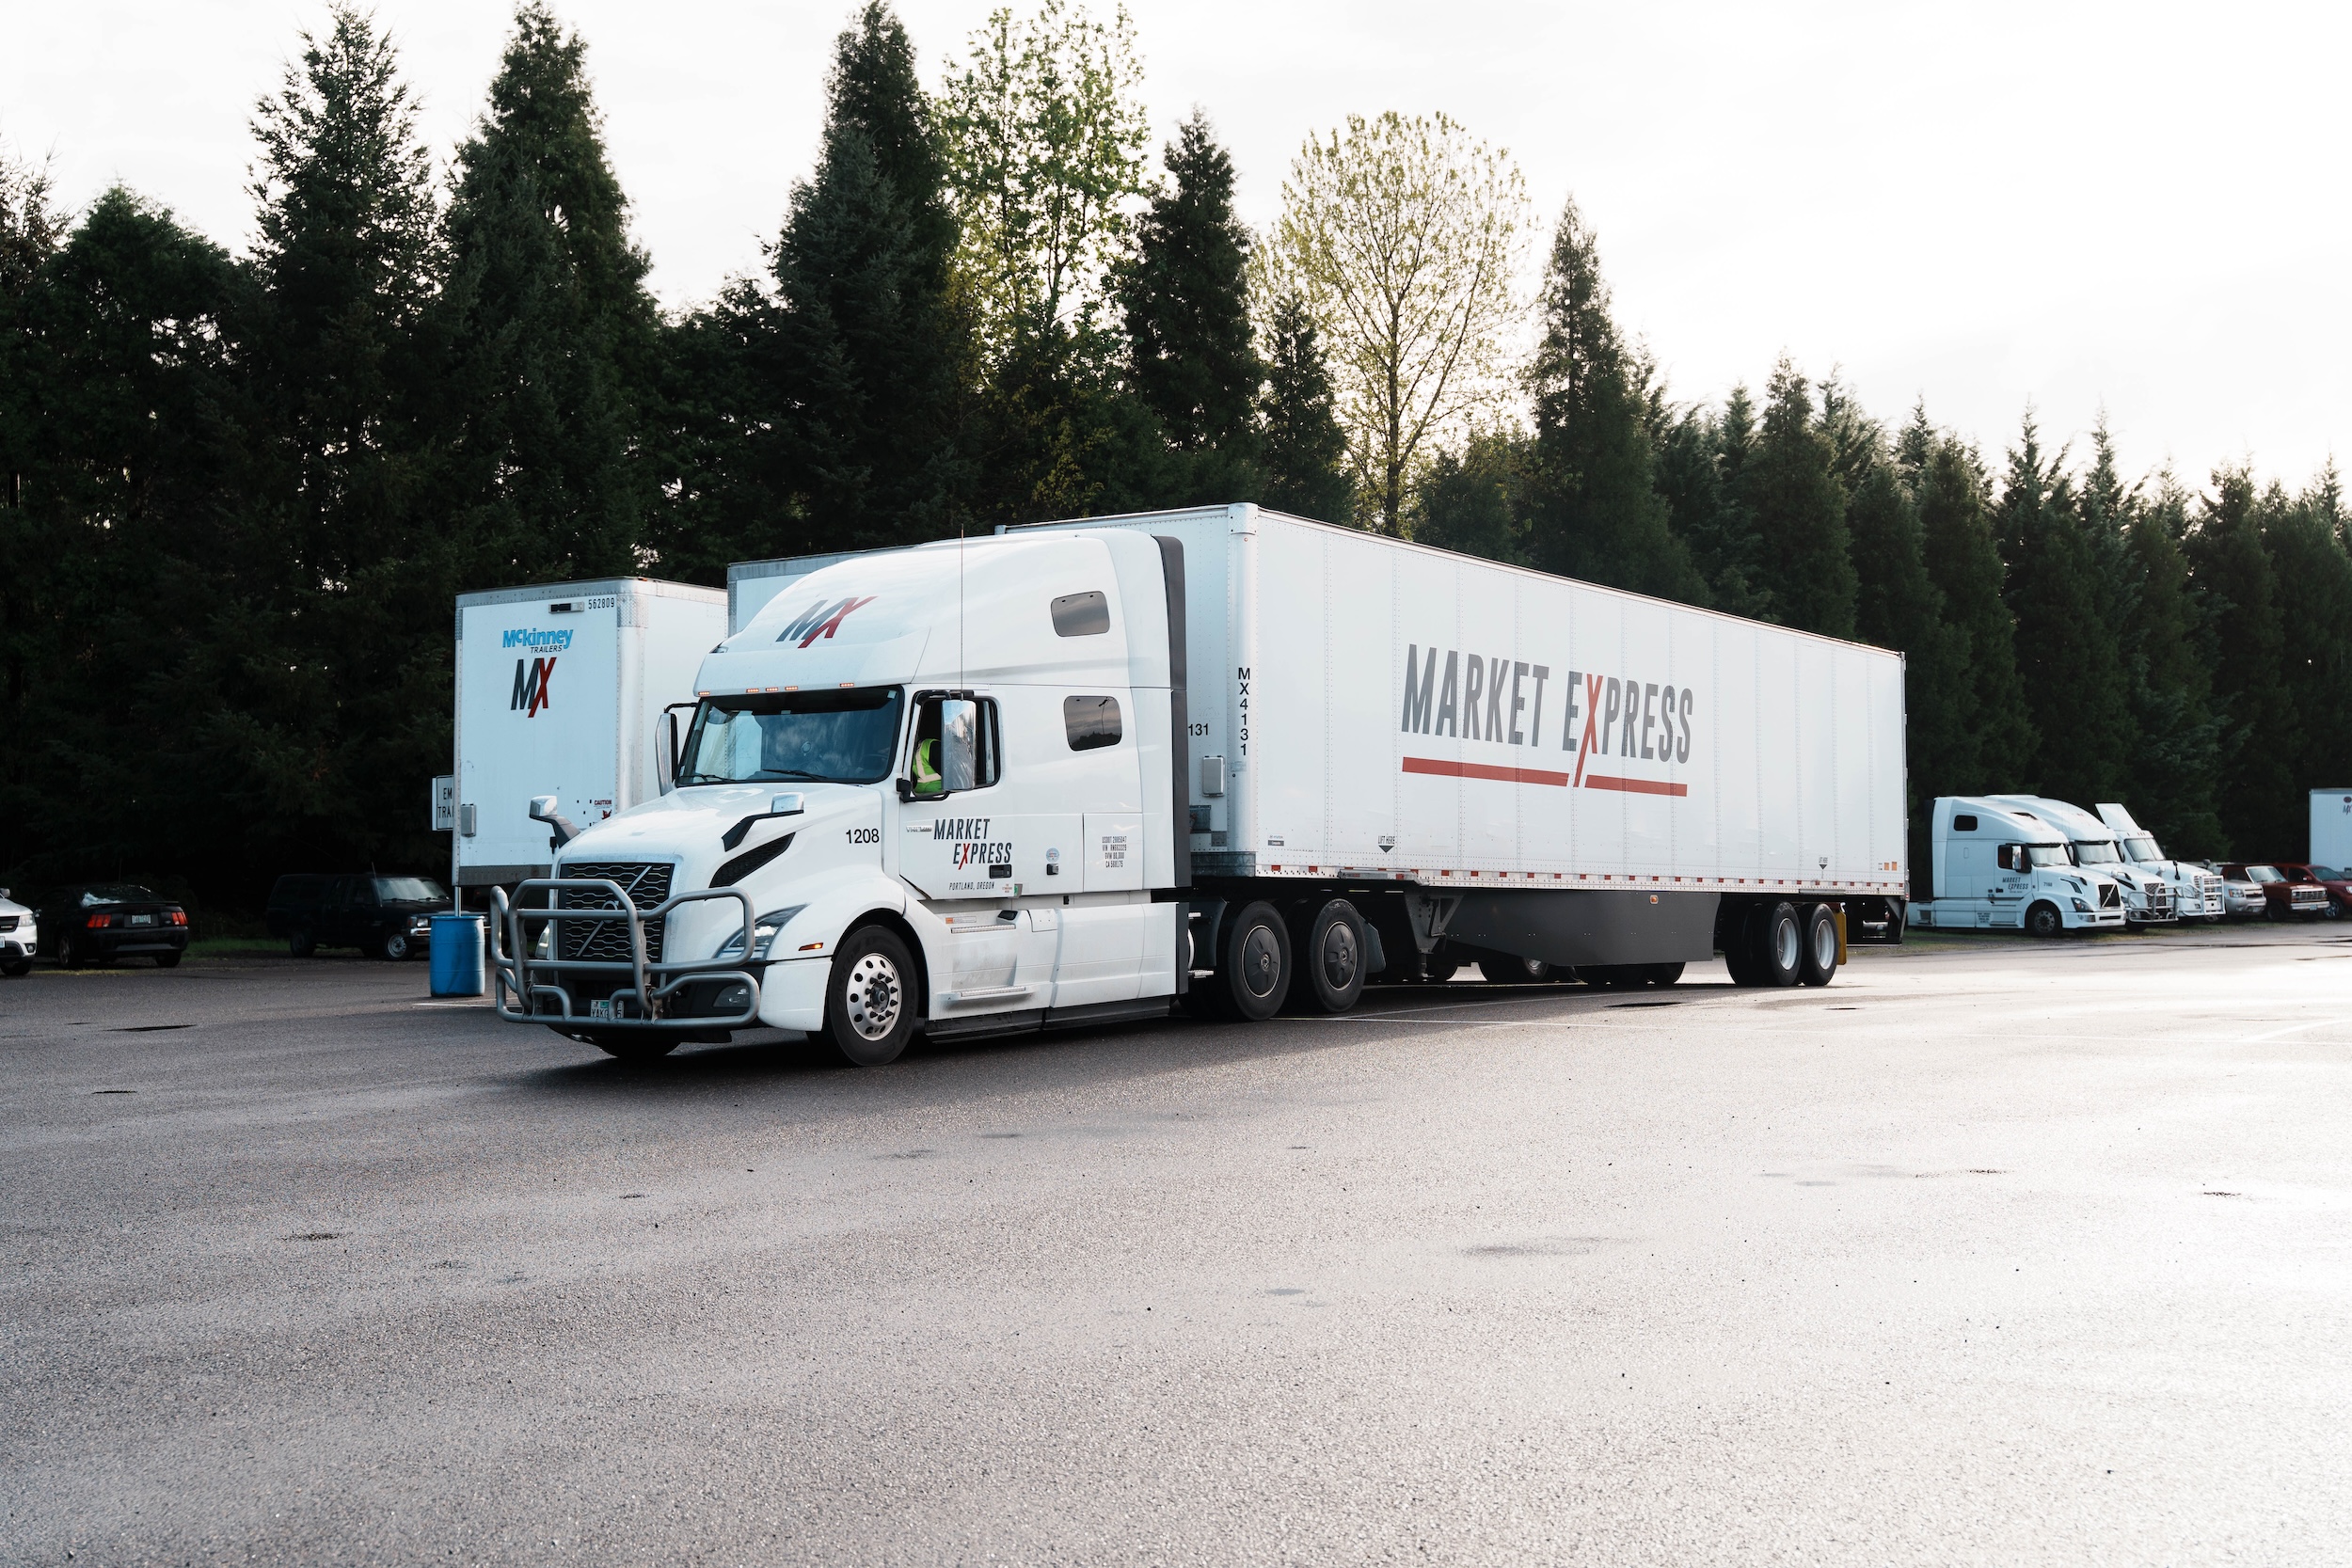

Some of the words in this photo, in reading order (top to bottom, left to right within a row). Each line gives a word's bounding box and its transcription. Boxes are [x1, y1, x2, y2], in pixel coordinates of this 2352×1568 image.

[588, 597, 615, 610] 562809
[531, 644, 563, 654] TRAILERS
[510, 657, 557, 718] MX
[1238, 667, 1250, 755] MX4131
[1402, 643, 1549, 747] MARKET
[1562, 671, 1693, 787] EXPRESS
[1187, 723, 1209, 736] 131
[443, 787, 453, 800] EM
[437, 806, 454, 818] TRAI
[846, 828, 880, 844] 1208
[933, 818, 990, 840] MARKET
[953, 842, 1012, 870] EXPRESS
[949, 882, 976, 891] PORTLAND,
[977, 881, 995, 890] OREGON
